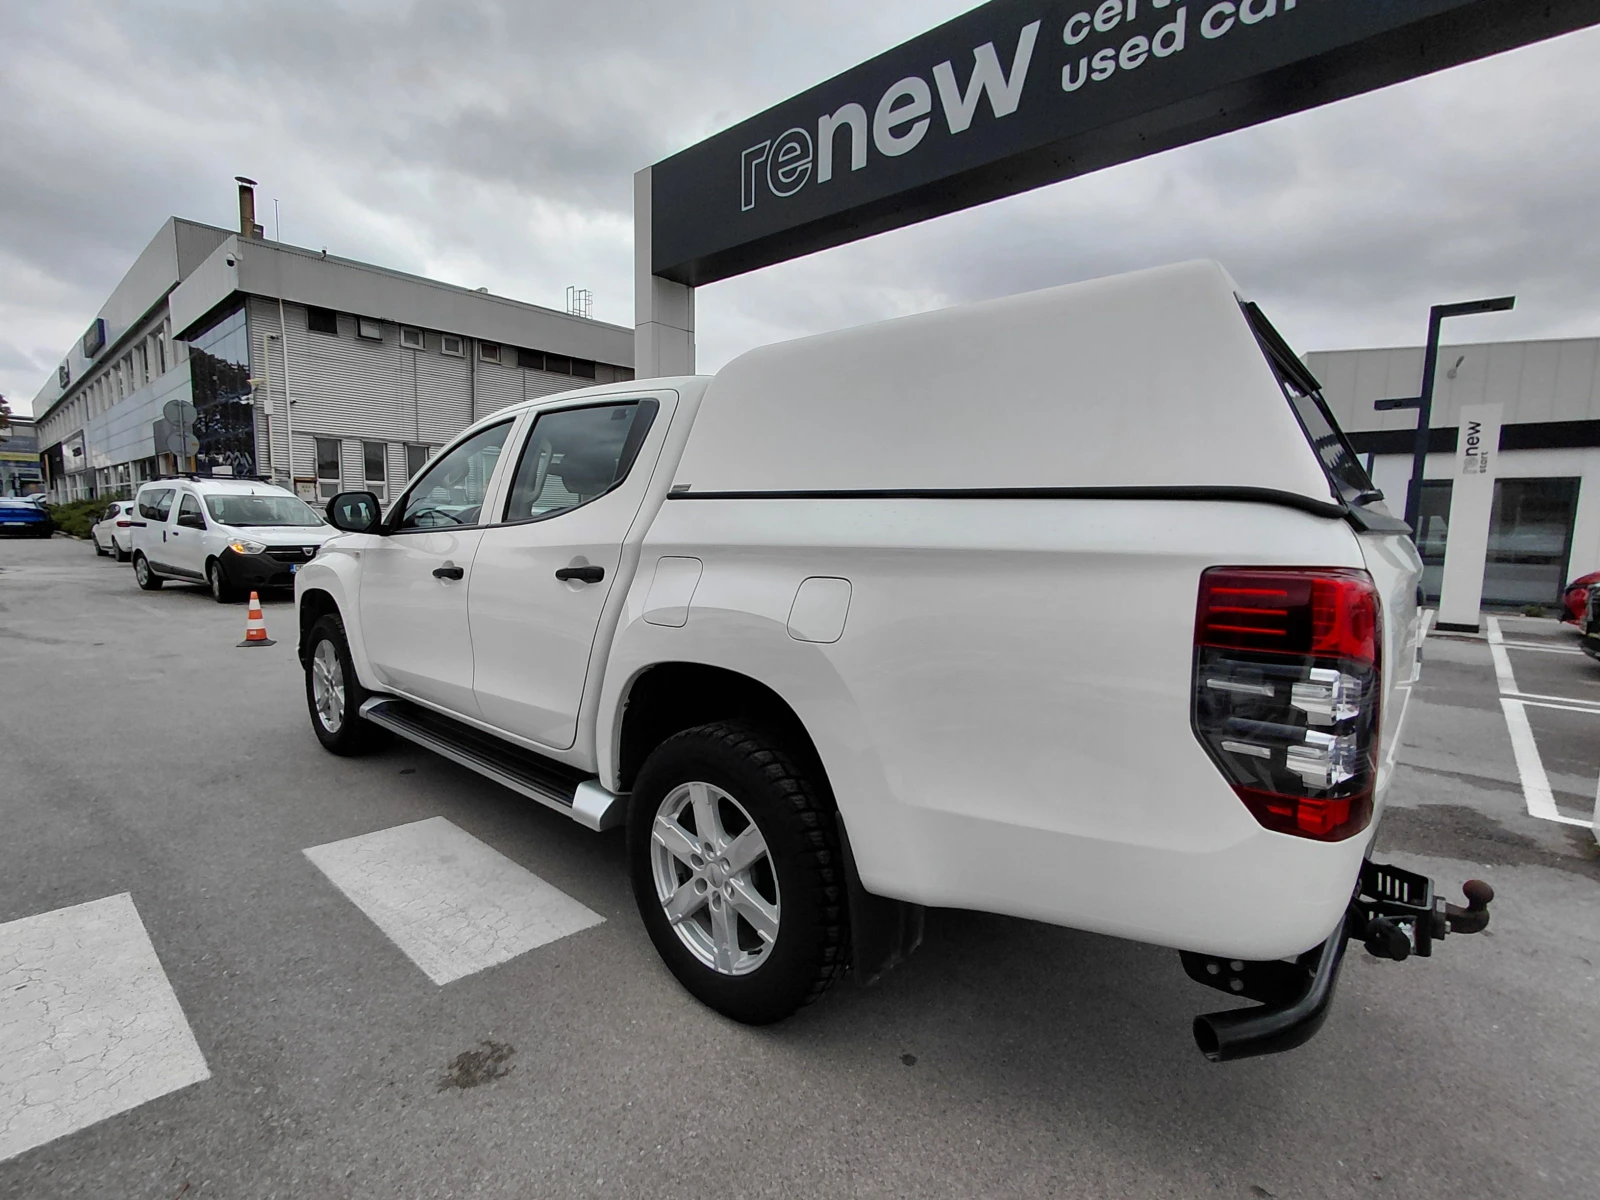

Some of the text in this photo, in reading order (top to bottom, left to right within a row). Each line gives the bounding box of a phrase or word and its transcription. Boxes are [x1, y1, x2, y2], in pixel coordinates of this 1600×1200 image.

[1061, 6, 1187, 92] used
[741, 21, 1041, 212] renew
[1463, 421, 1481, 474] renew
[1479, 452, 1488, 473] start
